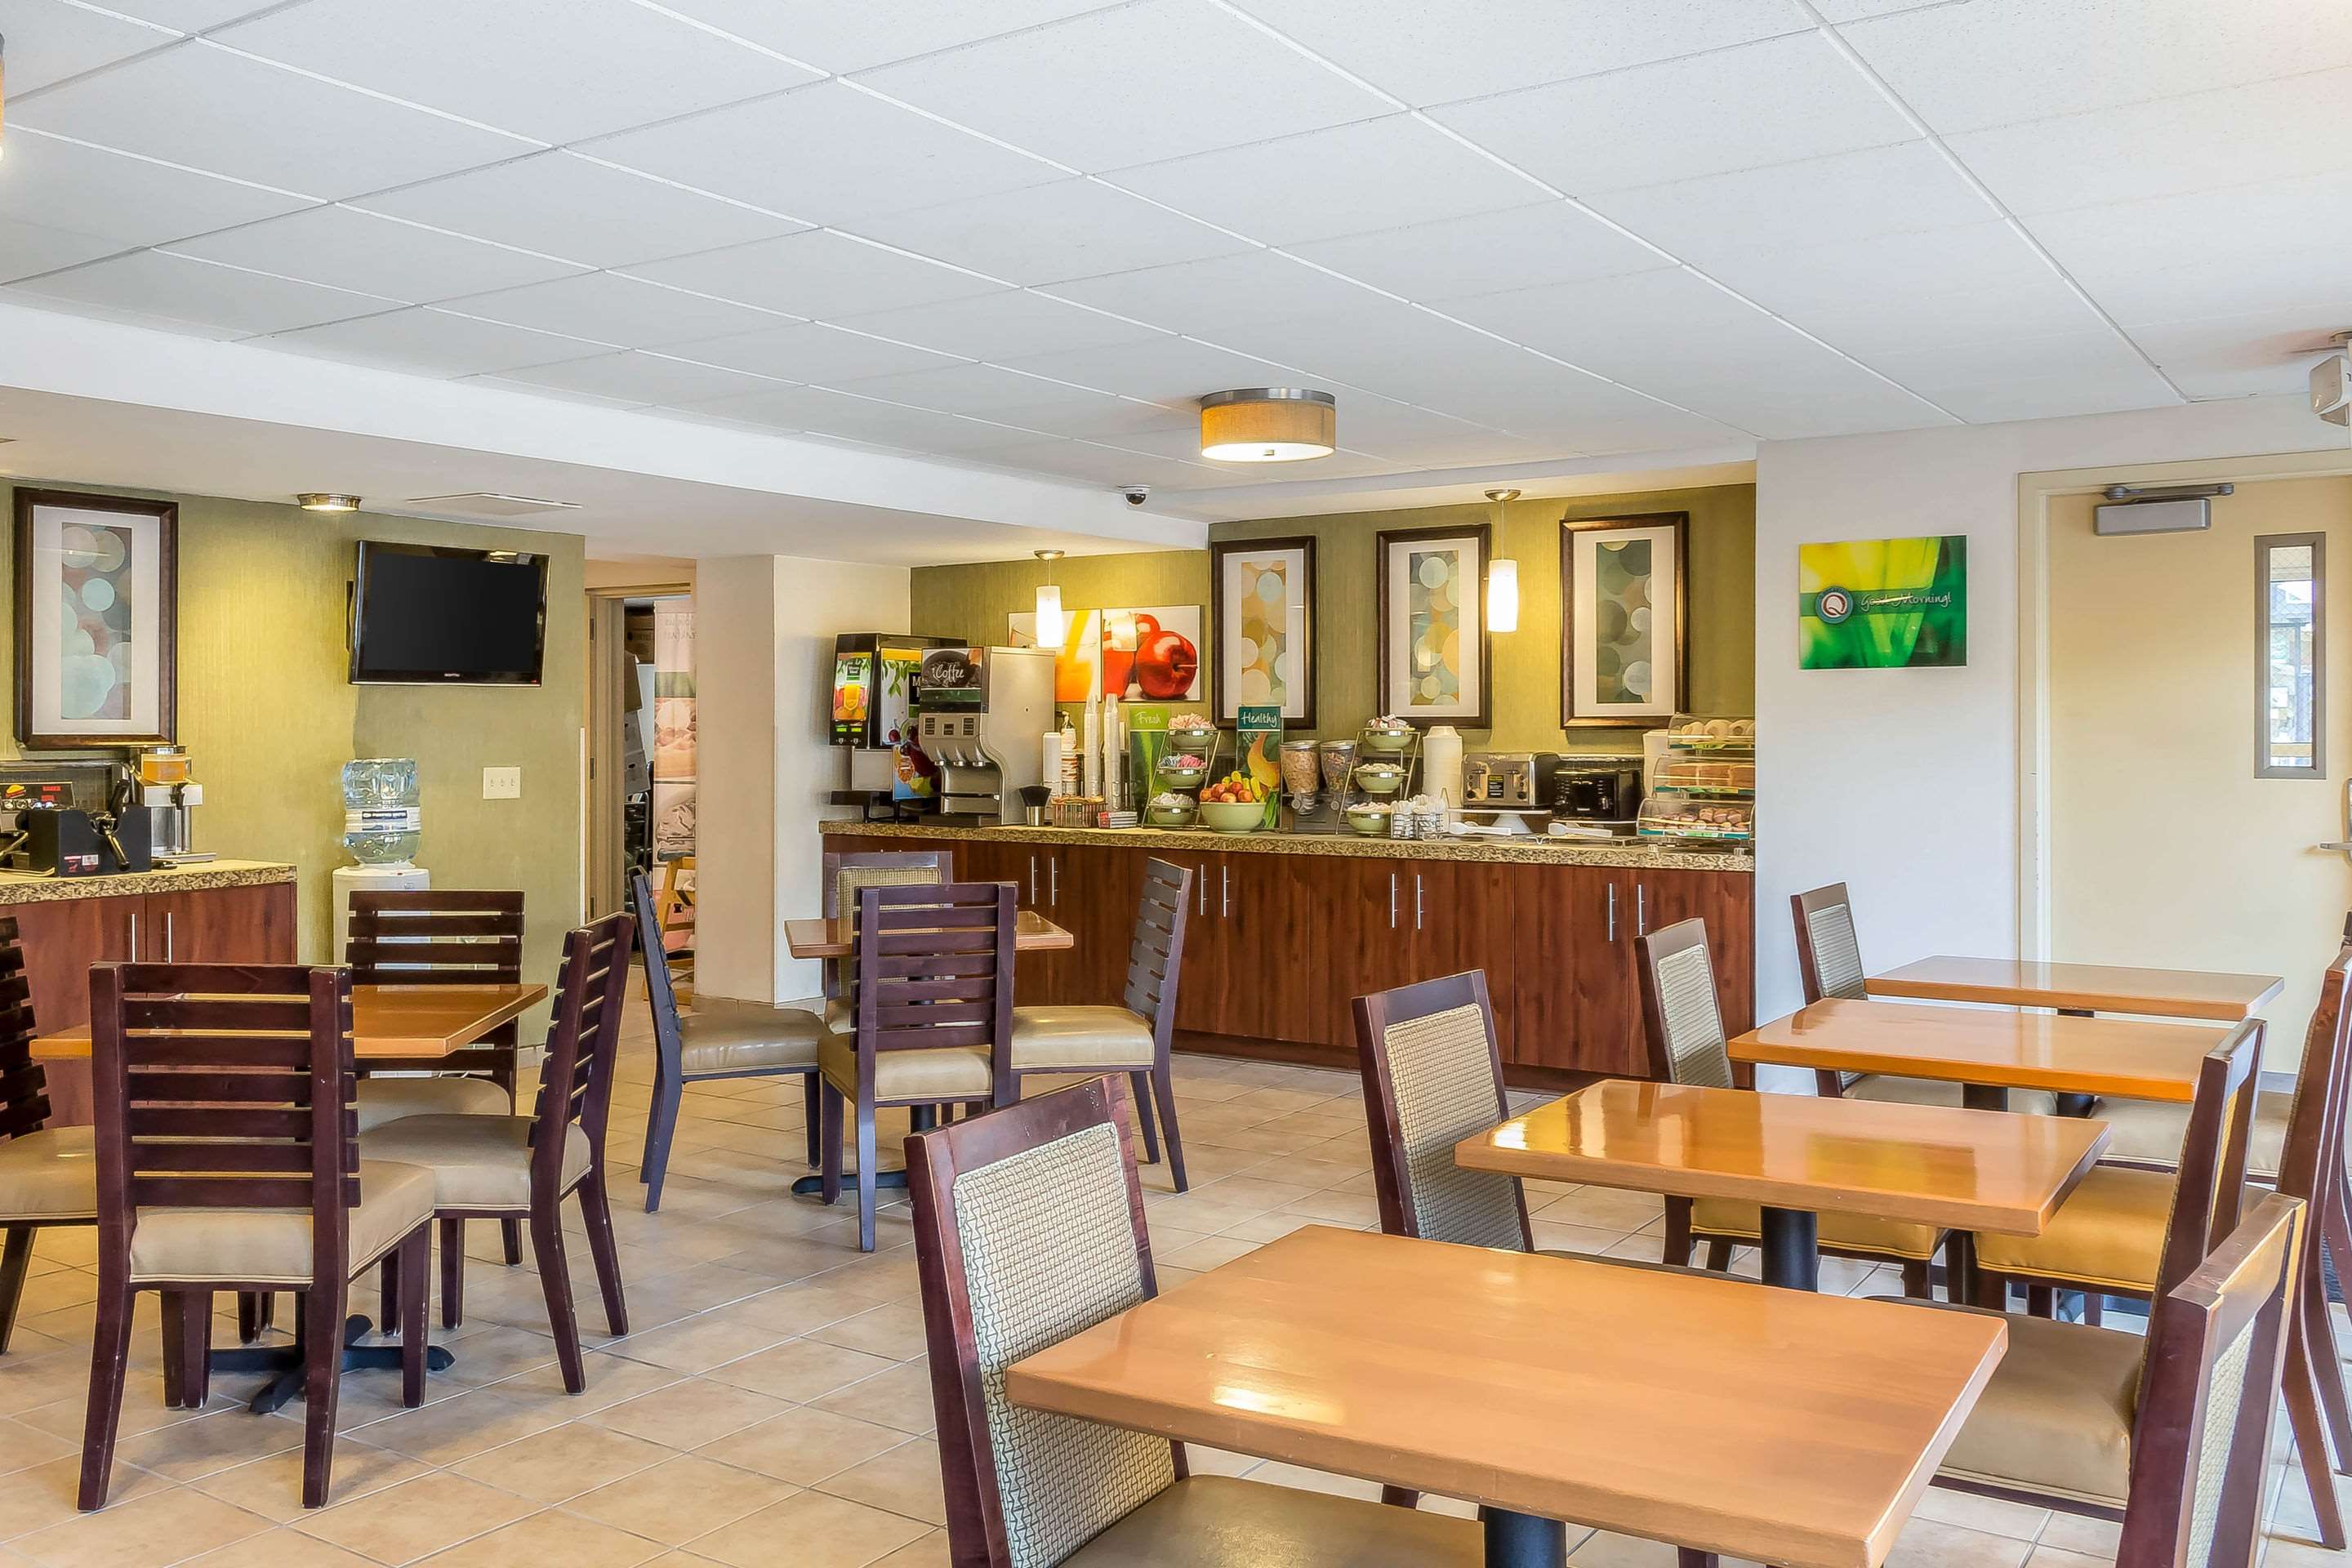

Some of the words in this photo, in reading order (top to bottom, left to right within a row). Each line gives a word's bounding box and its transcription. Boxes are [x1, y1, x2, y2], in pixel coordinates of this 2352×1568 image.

[935, 664, 965, 683] Coffee
[1135, 711, 1161, 724] Fresh
[1241, 711, 1277, 728] Healthy
